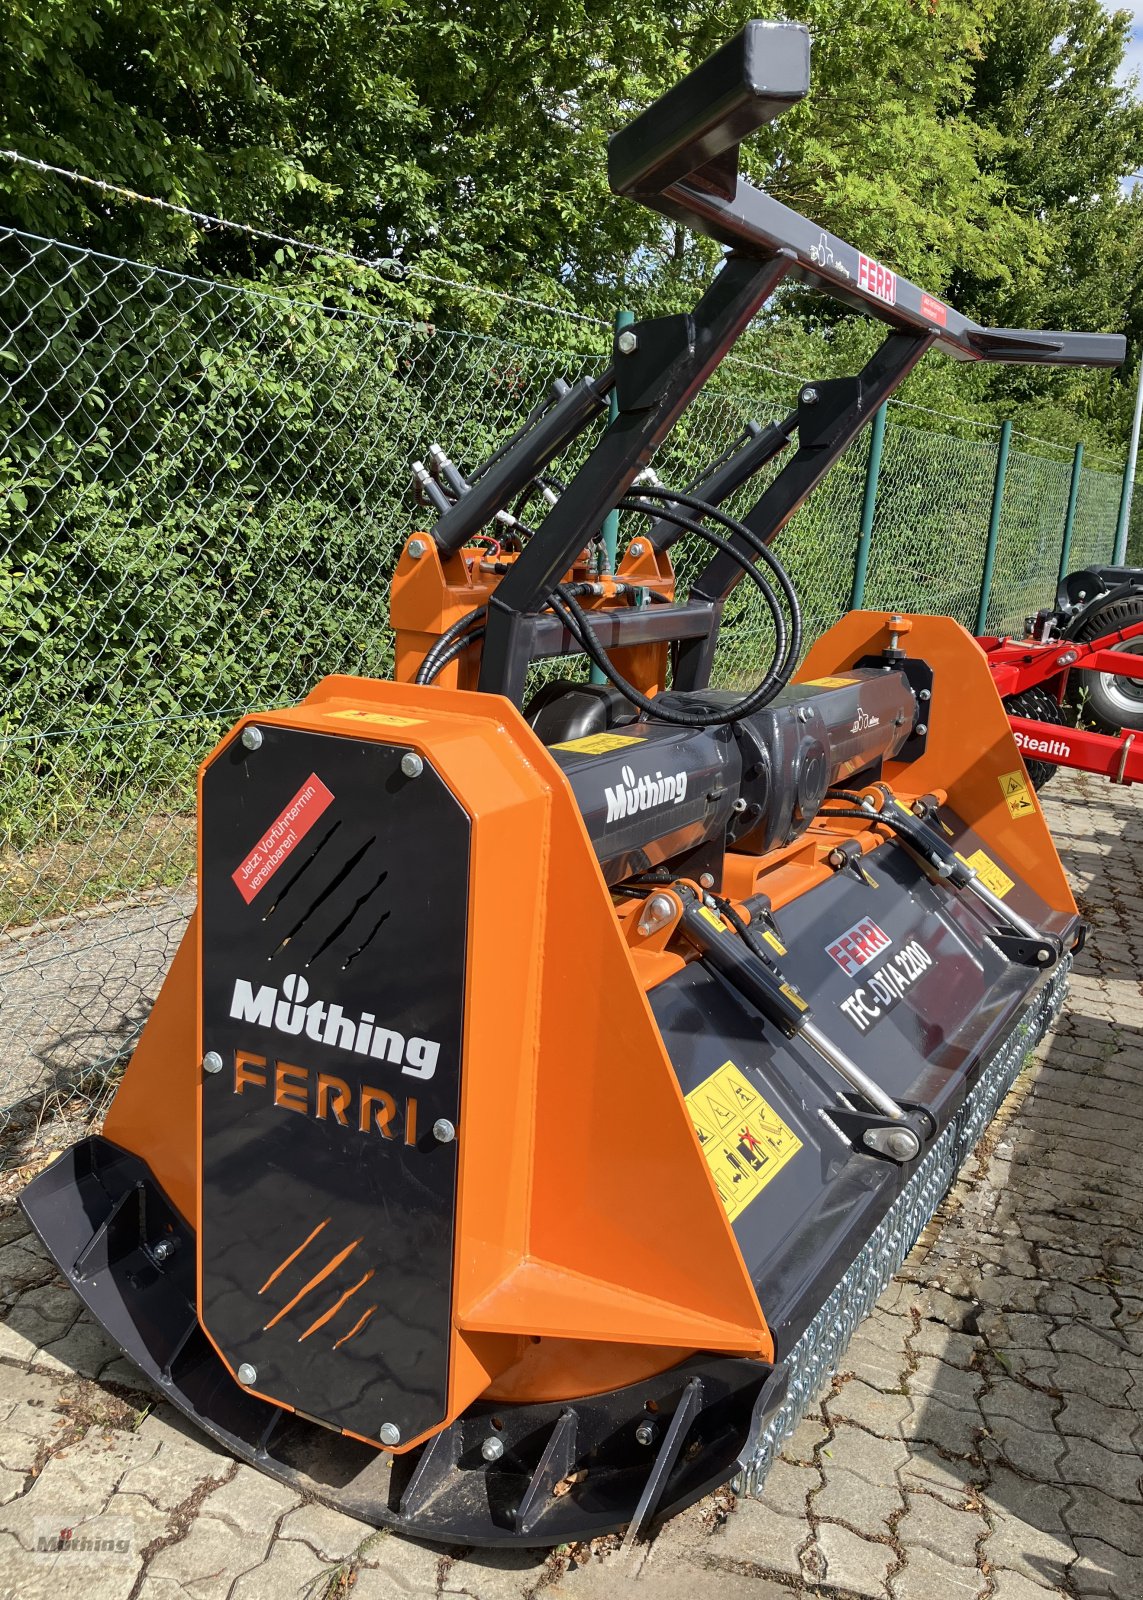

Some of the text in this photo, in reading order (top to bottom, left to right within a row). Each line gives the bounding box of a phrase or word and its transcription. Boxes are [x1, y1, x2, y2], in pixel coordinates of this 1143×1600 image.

[859, 255, 897, 303] FERRI
[1013, 731, 1071, 757] Stealth
[241, 785, 316, 880] Jetzt Vorführtermin
[249, 829, 298, 890] vereinbaren!
[828, 918, 890, 974] FERRI
[895, 940, 933, 981] 2200
[233, 1048, 418, 1147] FERRI
